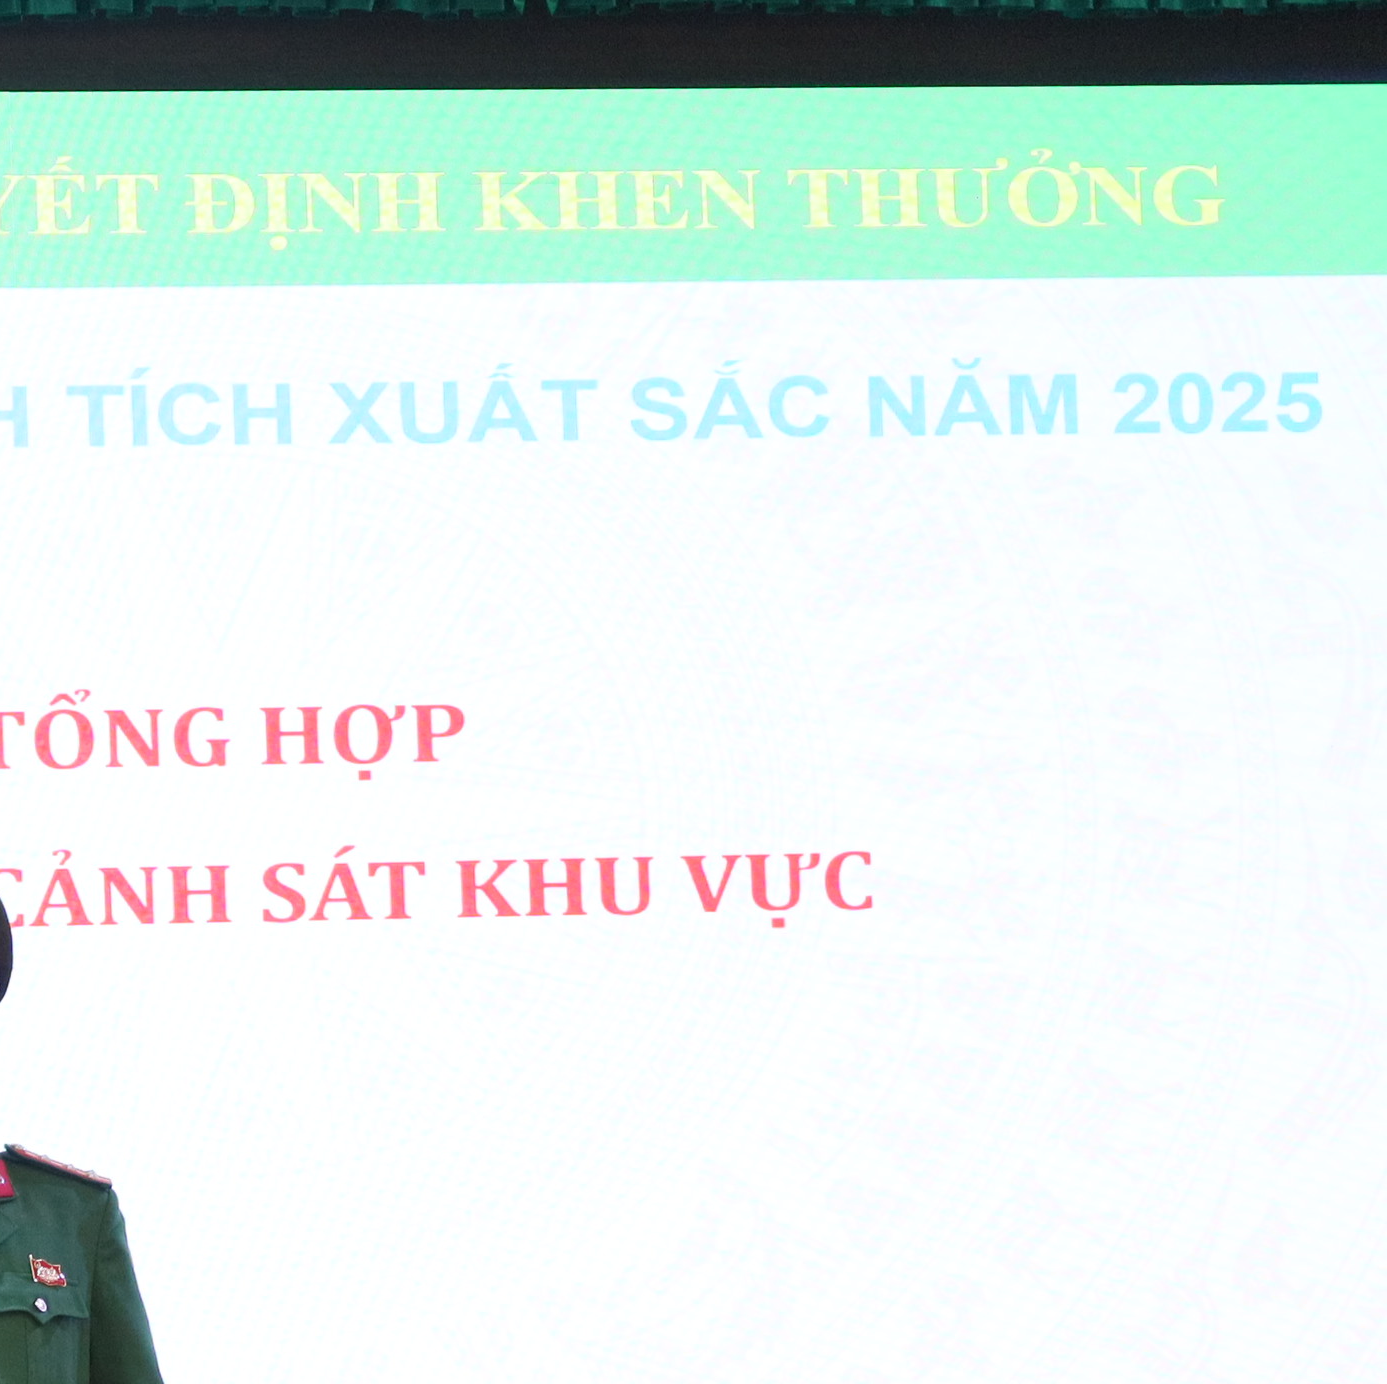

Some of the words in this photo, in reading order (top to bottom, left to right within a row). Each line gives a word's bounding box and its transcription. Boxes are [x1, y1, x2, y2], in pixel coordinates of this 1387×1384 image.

[184, 172, 444, 252] ĐỊNH
[475, 169, 761, 233] KHEN
[787, 147, 1226, 231] THƯỞNG
[66, 366, 293, 448] TÍCH
[329, 361, 599, 445] XUẤT
[630, 359, 831, 442] SẮC
[867, 356, 1079, 439] NĂM
[1113, 371, 1324, 435] 2025
[261, 704, 465, 780] HỢP
[263, 845, 425, 923] SÁT
[458, 856, 653, 918] KHU
[683, 850, 873, 928] VỰC
